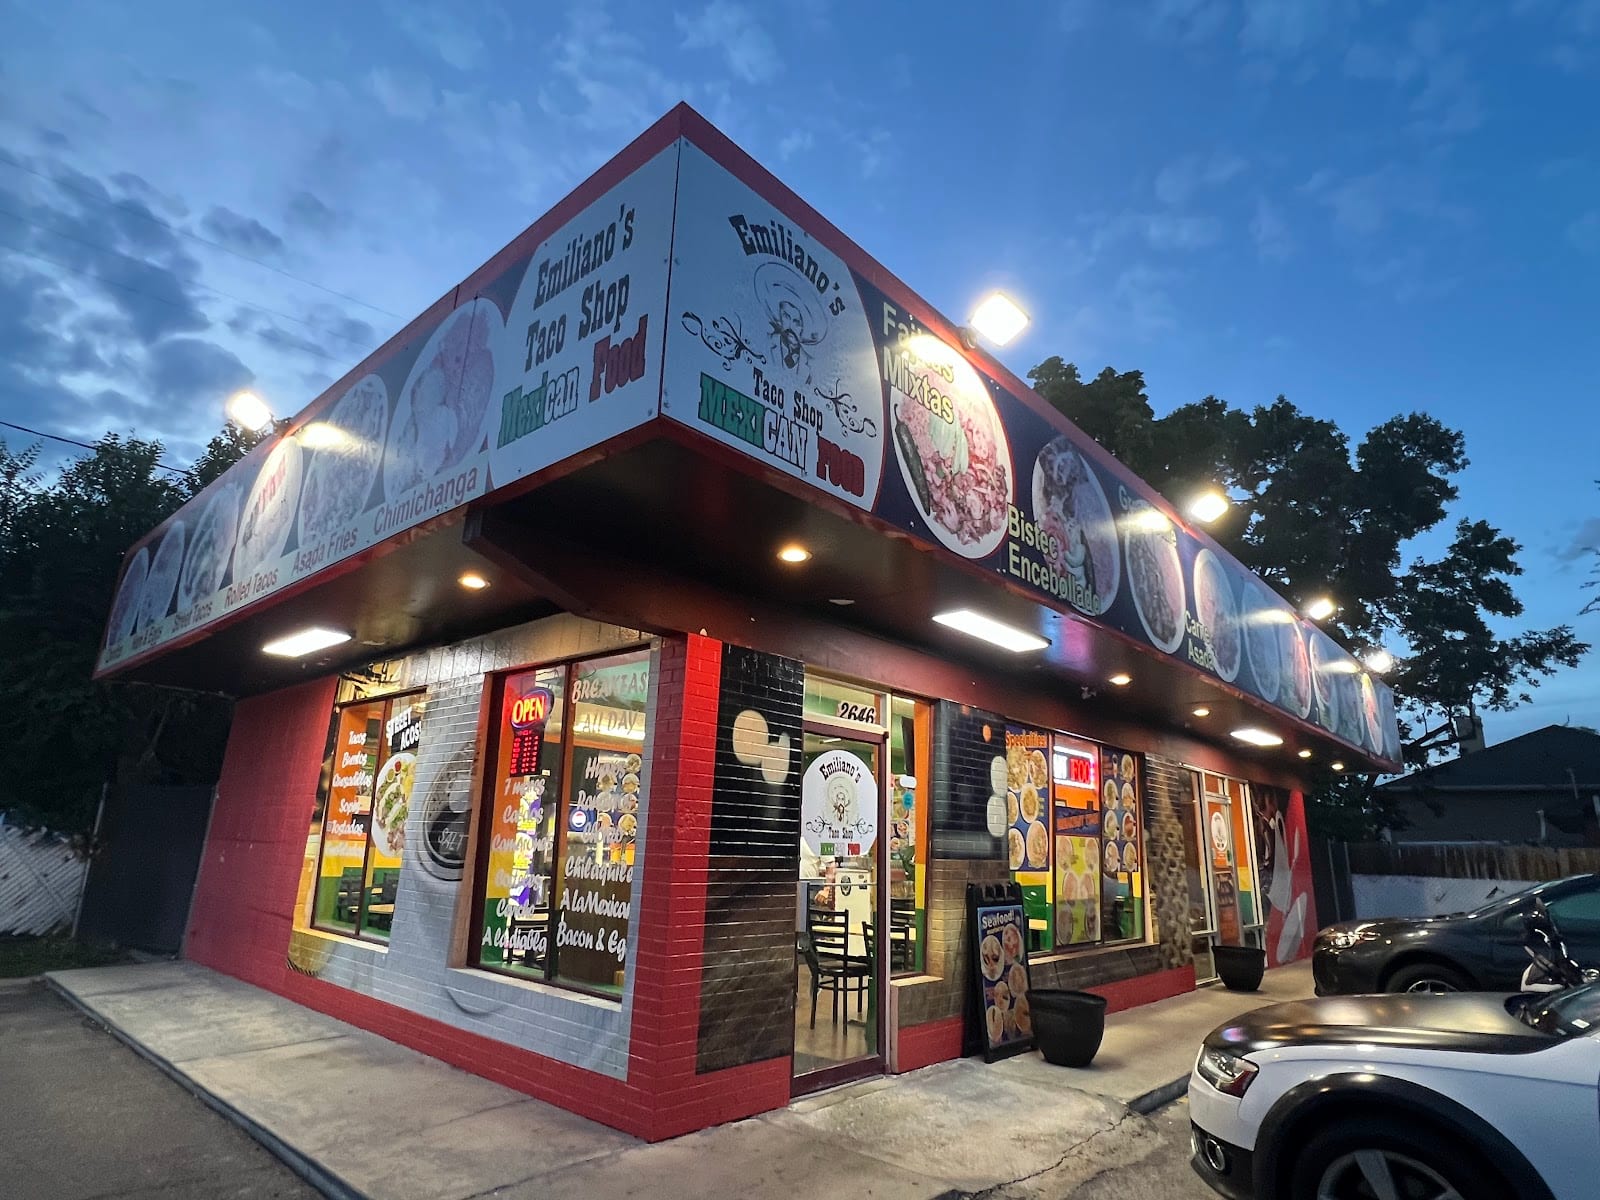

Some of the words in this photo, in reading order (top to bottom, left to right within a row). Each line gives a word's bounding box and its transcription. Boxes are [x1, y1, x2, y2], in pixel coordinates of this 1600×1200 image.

[534, 204, 635, 311] Emiliano's
[728, 214, 845, 317] Emiliano's
[525, 312, 567, 372] Taco
[578, 274, 630, 342] Shop
[497, 366, 579, 449] Mexican
[589, 313, 648, 402] Food
[752, 367, 785, 410] Taco
[793, 391, 823, 434] Shop
[883, 345, 955, 425] Mixtas
[697, 372, 809, 470] MEXICAN
[816, 434, 865, 498] FOOD
[374, 467, 478, 536] Chimichanga
[1007, 502, 1058, 560] Bistec
[252, 567, 279, 595] Tacos
[291, 542, 324, 577] Asada
[326, 527, 359, 558] Fries
[1008, 541, 1101, 614] Encebollado
[1184, 609, 1212, 644] Carne
[512, 695, 544, 724] OPEN
[608, 711, 637, 735] DAY
[482, 926, 492, 946] A
[556, 921, 594, 950] Bacon
[595, 927, 605, 952] &
